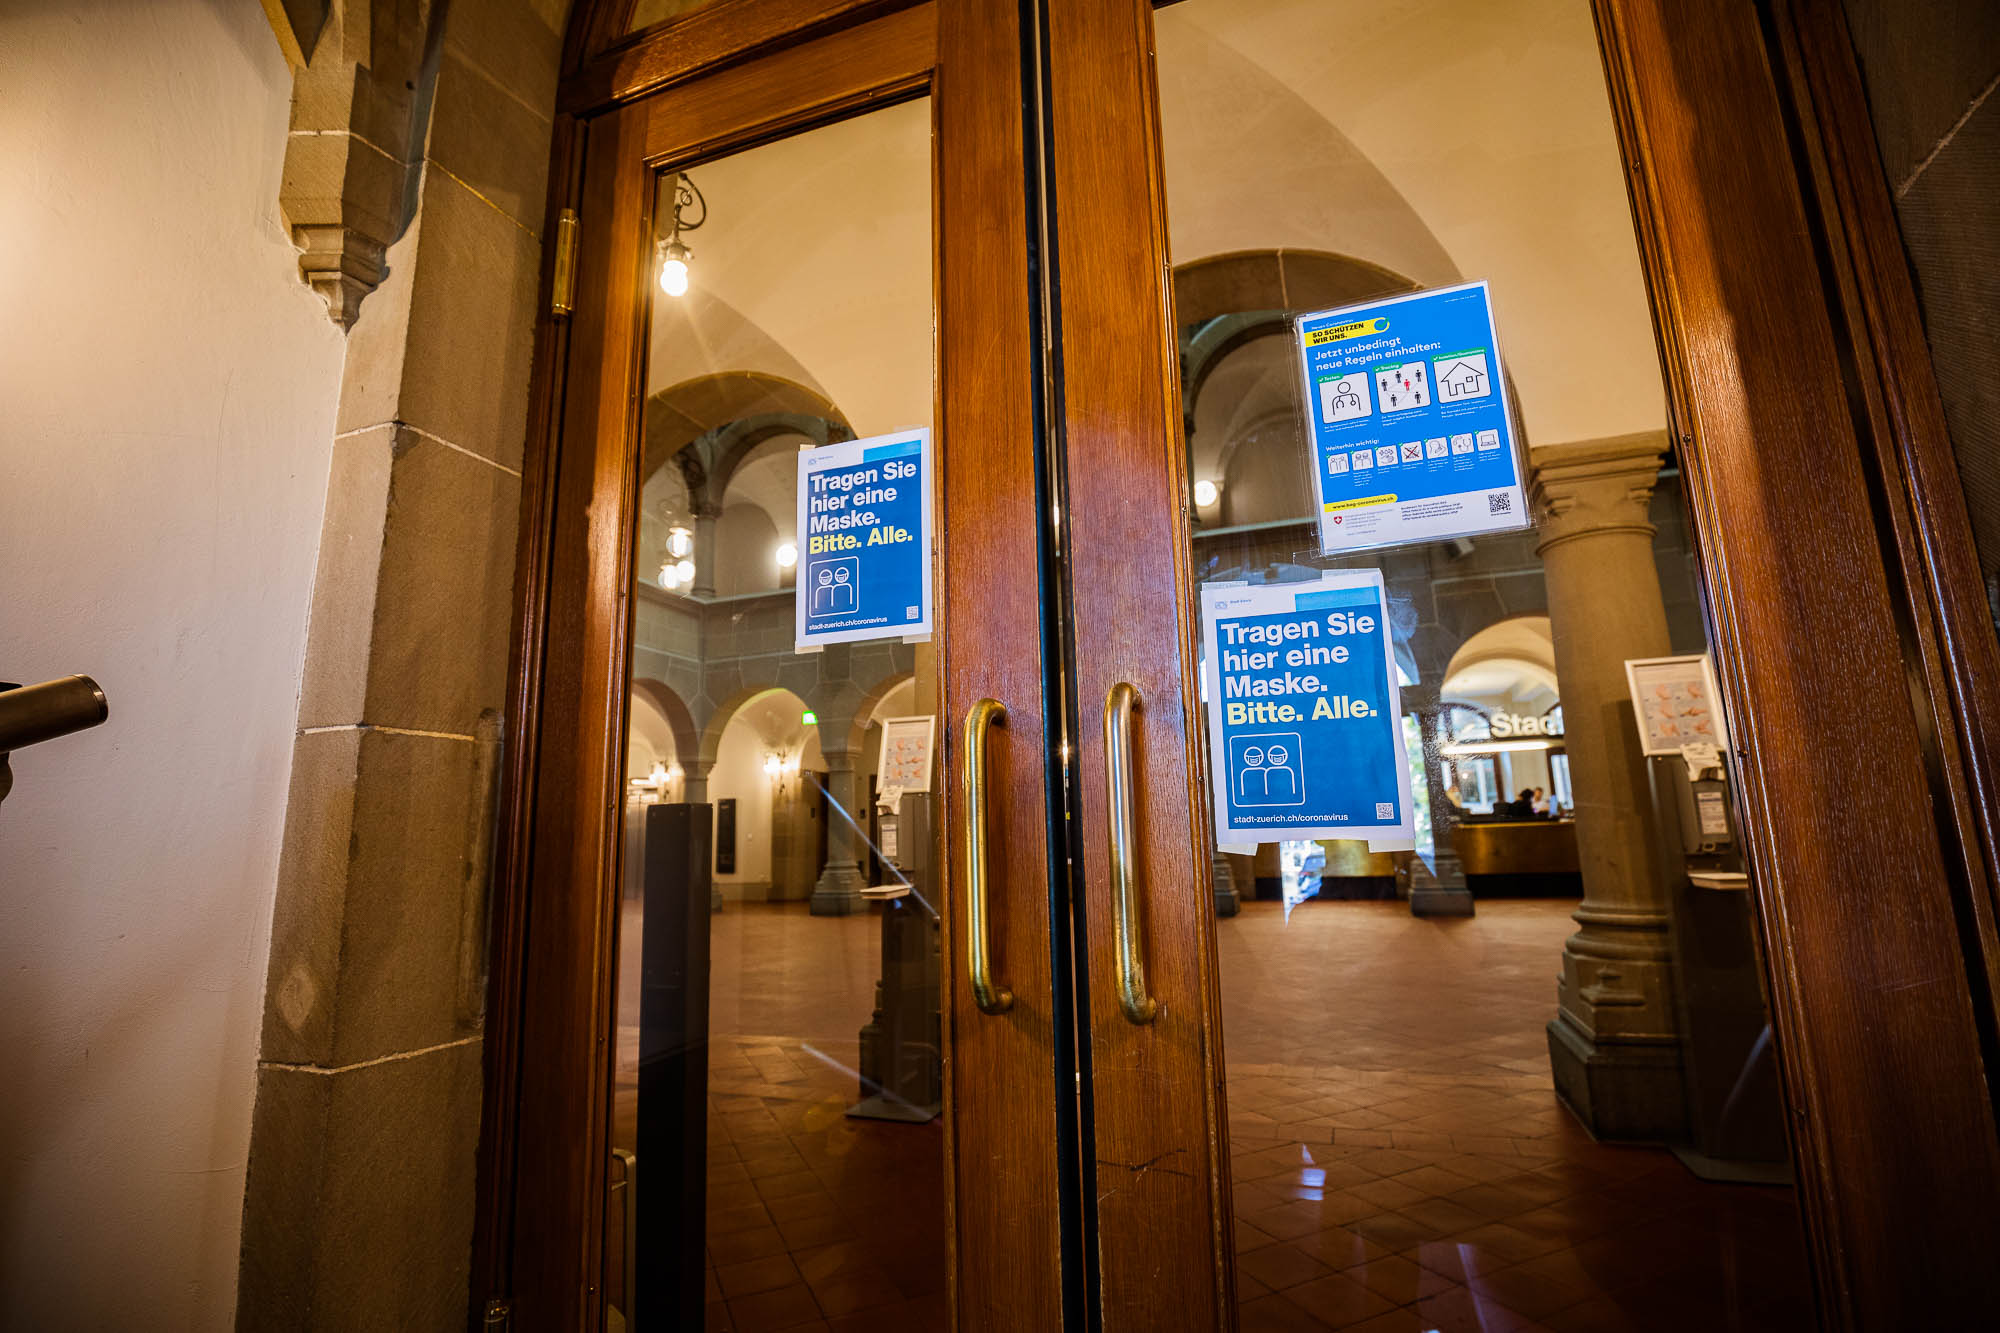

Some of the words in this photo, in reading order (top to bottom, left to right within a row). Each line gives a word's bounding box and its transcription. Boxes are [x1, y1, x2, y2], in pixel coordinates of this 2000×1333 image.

[1312, 331, 1323, 339] SO
[1324, 322, 1365, 336] SCHÜTZEN
[1313, 336, 1328, 344] WIR
[1329, 333, 1348, 341] UNS.
[1315, 347, 1342, 360] Jetzt
[1344, 337, 1401, 355] unbedingt
[1315, 360, 1343, 372] neue
[1345, 351, 1383, 366] Regeln
[1385, 341, 1441, 358] einhalten:
[810, 468, 878, 493] Tragen
[882, 461, 916, 482] Sie
[810, 494, 849, 514] hier
[852, 487, 897, 506] eine
[809, 510, 881, 534] Maske.
[809, 534, 862, 555] Bitte.
[866, 526, 913, 547] Alle.
[808, 616, 888, 631] stadt-zuerich.ch/coronavirus
[1221, 620, 1319, 646] Tragen
[1327, 612, 1375, 636] Sie
[1223, 649, 1278, 672] hier
[1285, 644, 1349, 667] eine
[1225, 672, 1328, 699] Maske.
[1226, 702, 1304, 726] Bitte.
[1311, 695, 1378, 721] Alle.
[1233, 813, 1349, 824] stadt-zuerich.ch/coronavirus
